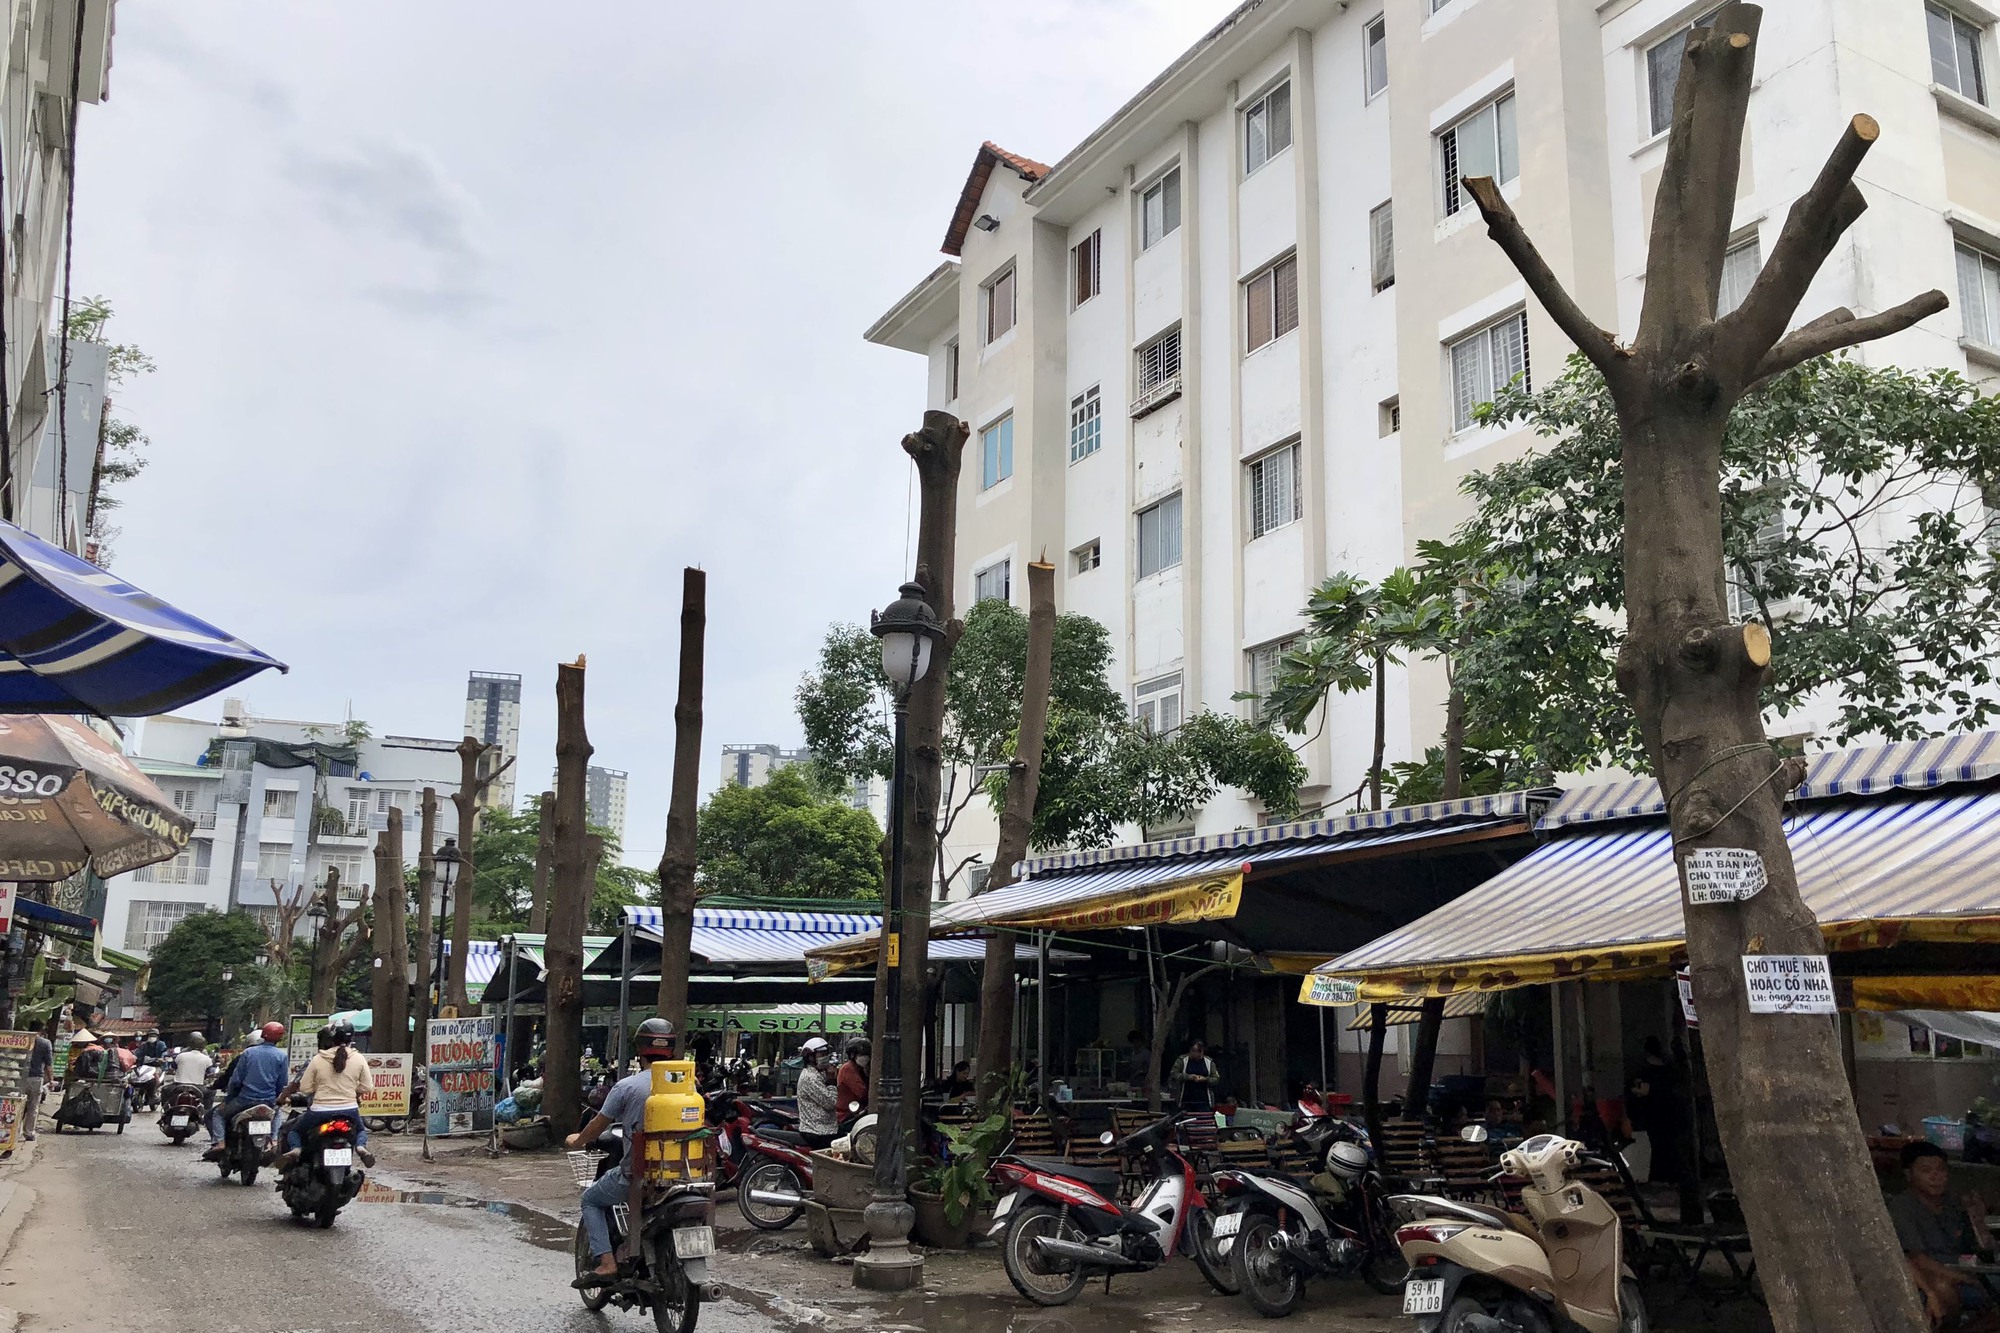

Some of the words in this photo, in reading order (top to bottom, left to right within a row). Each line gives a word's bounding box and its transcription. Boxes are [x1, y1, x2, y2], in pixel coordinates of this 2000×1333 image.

[1688, 860, 1713, 869] MUA
[1689, 871, 1711, 881] CHO
[1747, 960, 1769, 974] CHO
[1771, 957, 1800, 974] THUÊ
[1803, 957, 1826, 974] NHÀ
[1804, 975, 1829, 991] NHÀ
[1752, 994, 1767, 1002] LH:
[382, 1091, 402, 1101] 25K
